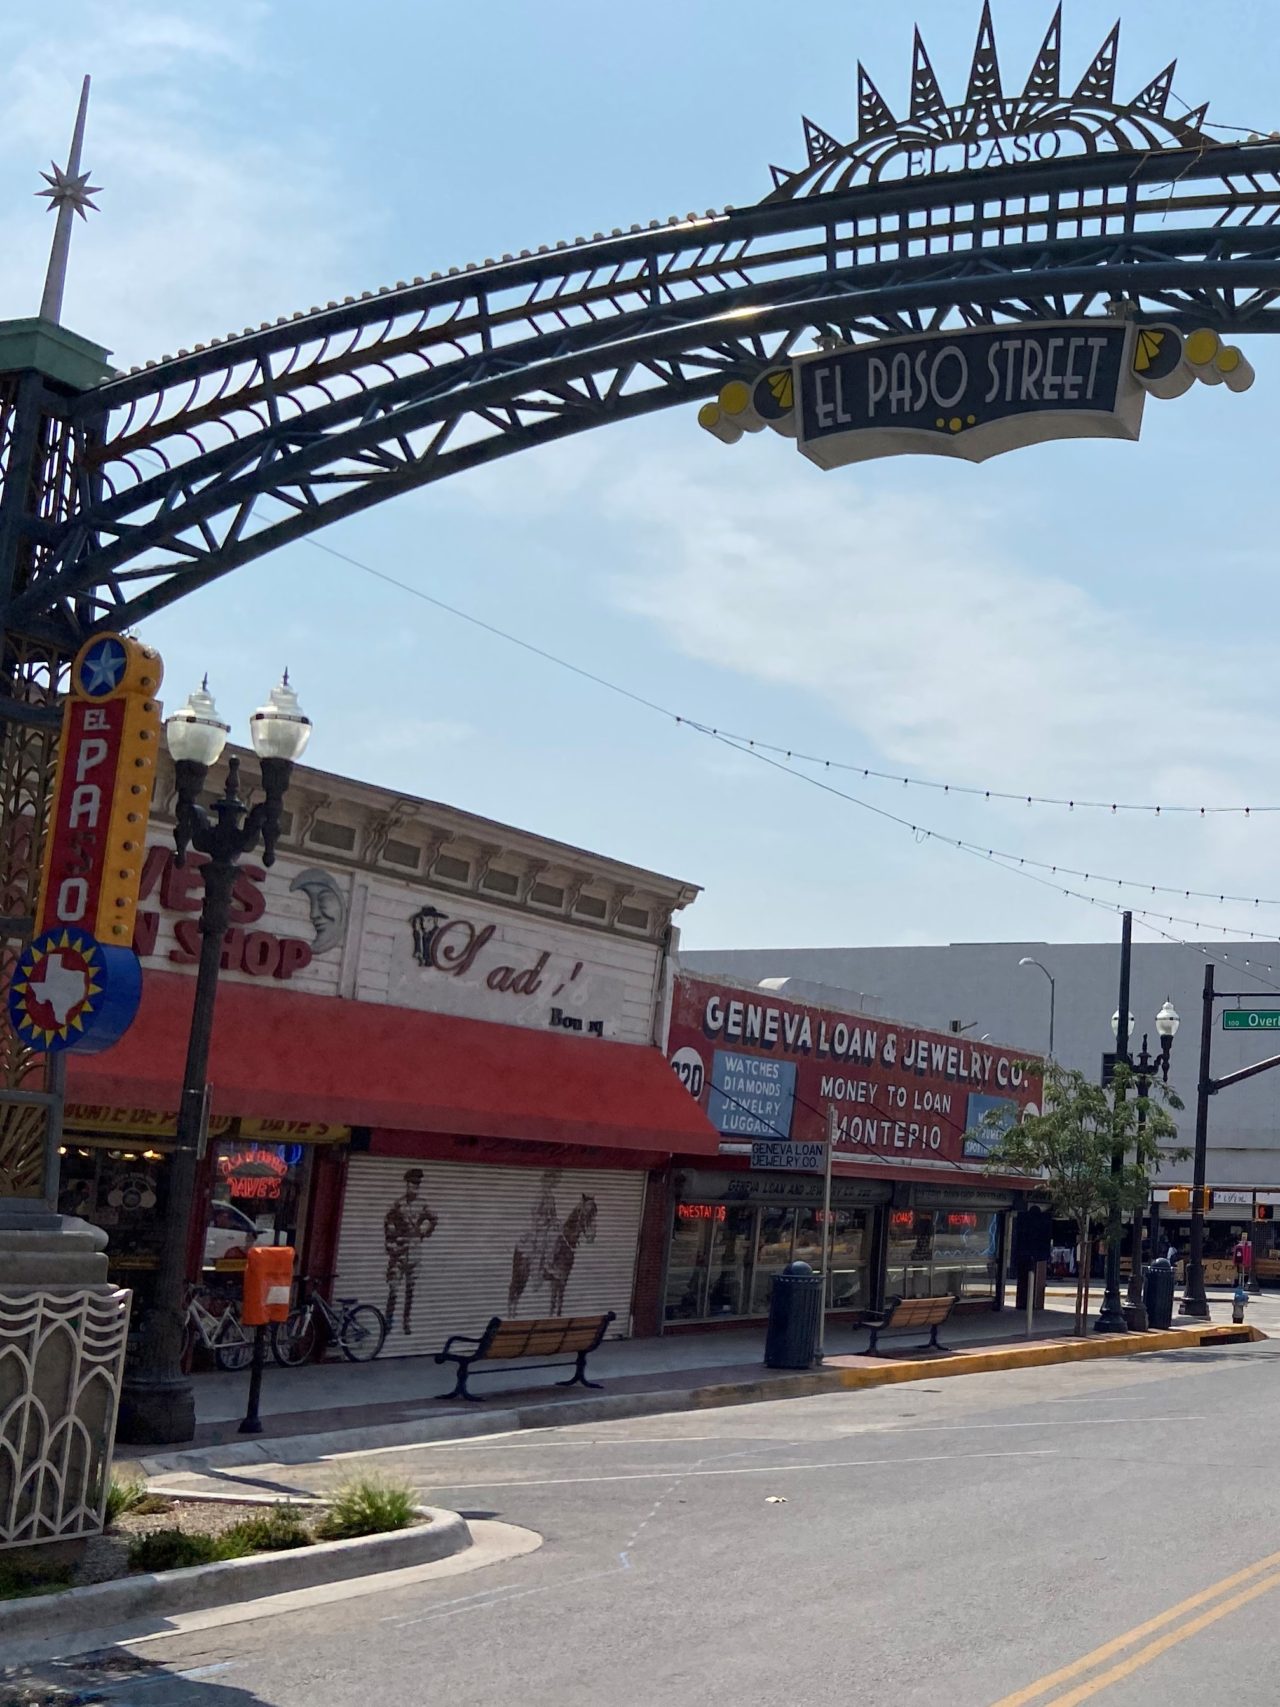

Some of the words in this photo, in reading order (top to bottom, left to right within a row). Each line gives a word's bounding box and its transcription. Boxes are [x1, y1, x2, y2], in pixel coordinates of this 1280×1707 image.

[906, 143, 950, 178] EL
[967, 130, 1061, 170] PASO
[815, 366, 851, 428] EL
[868, 345, 969, 417] PASO
[985, 337, 1108, 403] STREET
[83, 708, 111, 731] EL
[56, 738, 108, 922] PASO
[169, 920, 312, 979] SHOP
[706, 996, 813, 1049] GENEVA
[819, 1019, 877, 1060] LOAN
[883, 1033, 897, 1063] &
[904, 1039, 993, 1081] JEWELRY
[725, 1055, 780, 1079] WATCHES
[723, 1075, 781, 1097] DIAMONDS
[820, 1075, 878, 1105] MONEY
[887, 1085, 908, 1108] TO
[913, 1090, 952, 1114] LOAN
[722, 1096, 782, 1116] JEWELRY
[722, 1114, 776, 1134] LUGGAGE
[752, 1142, 794, 1156] GENEVA
[796, 1144, 823, 1157] LOAN
[752, 1156, 800, 1168] JEWELRY
[227, 1176, 281, 1199] DAVE'S
